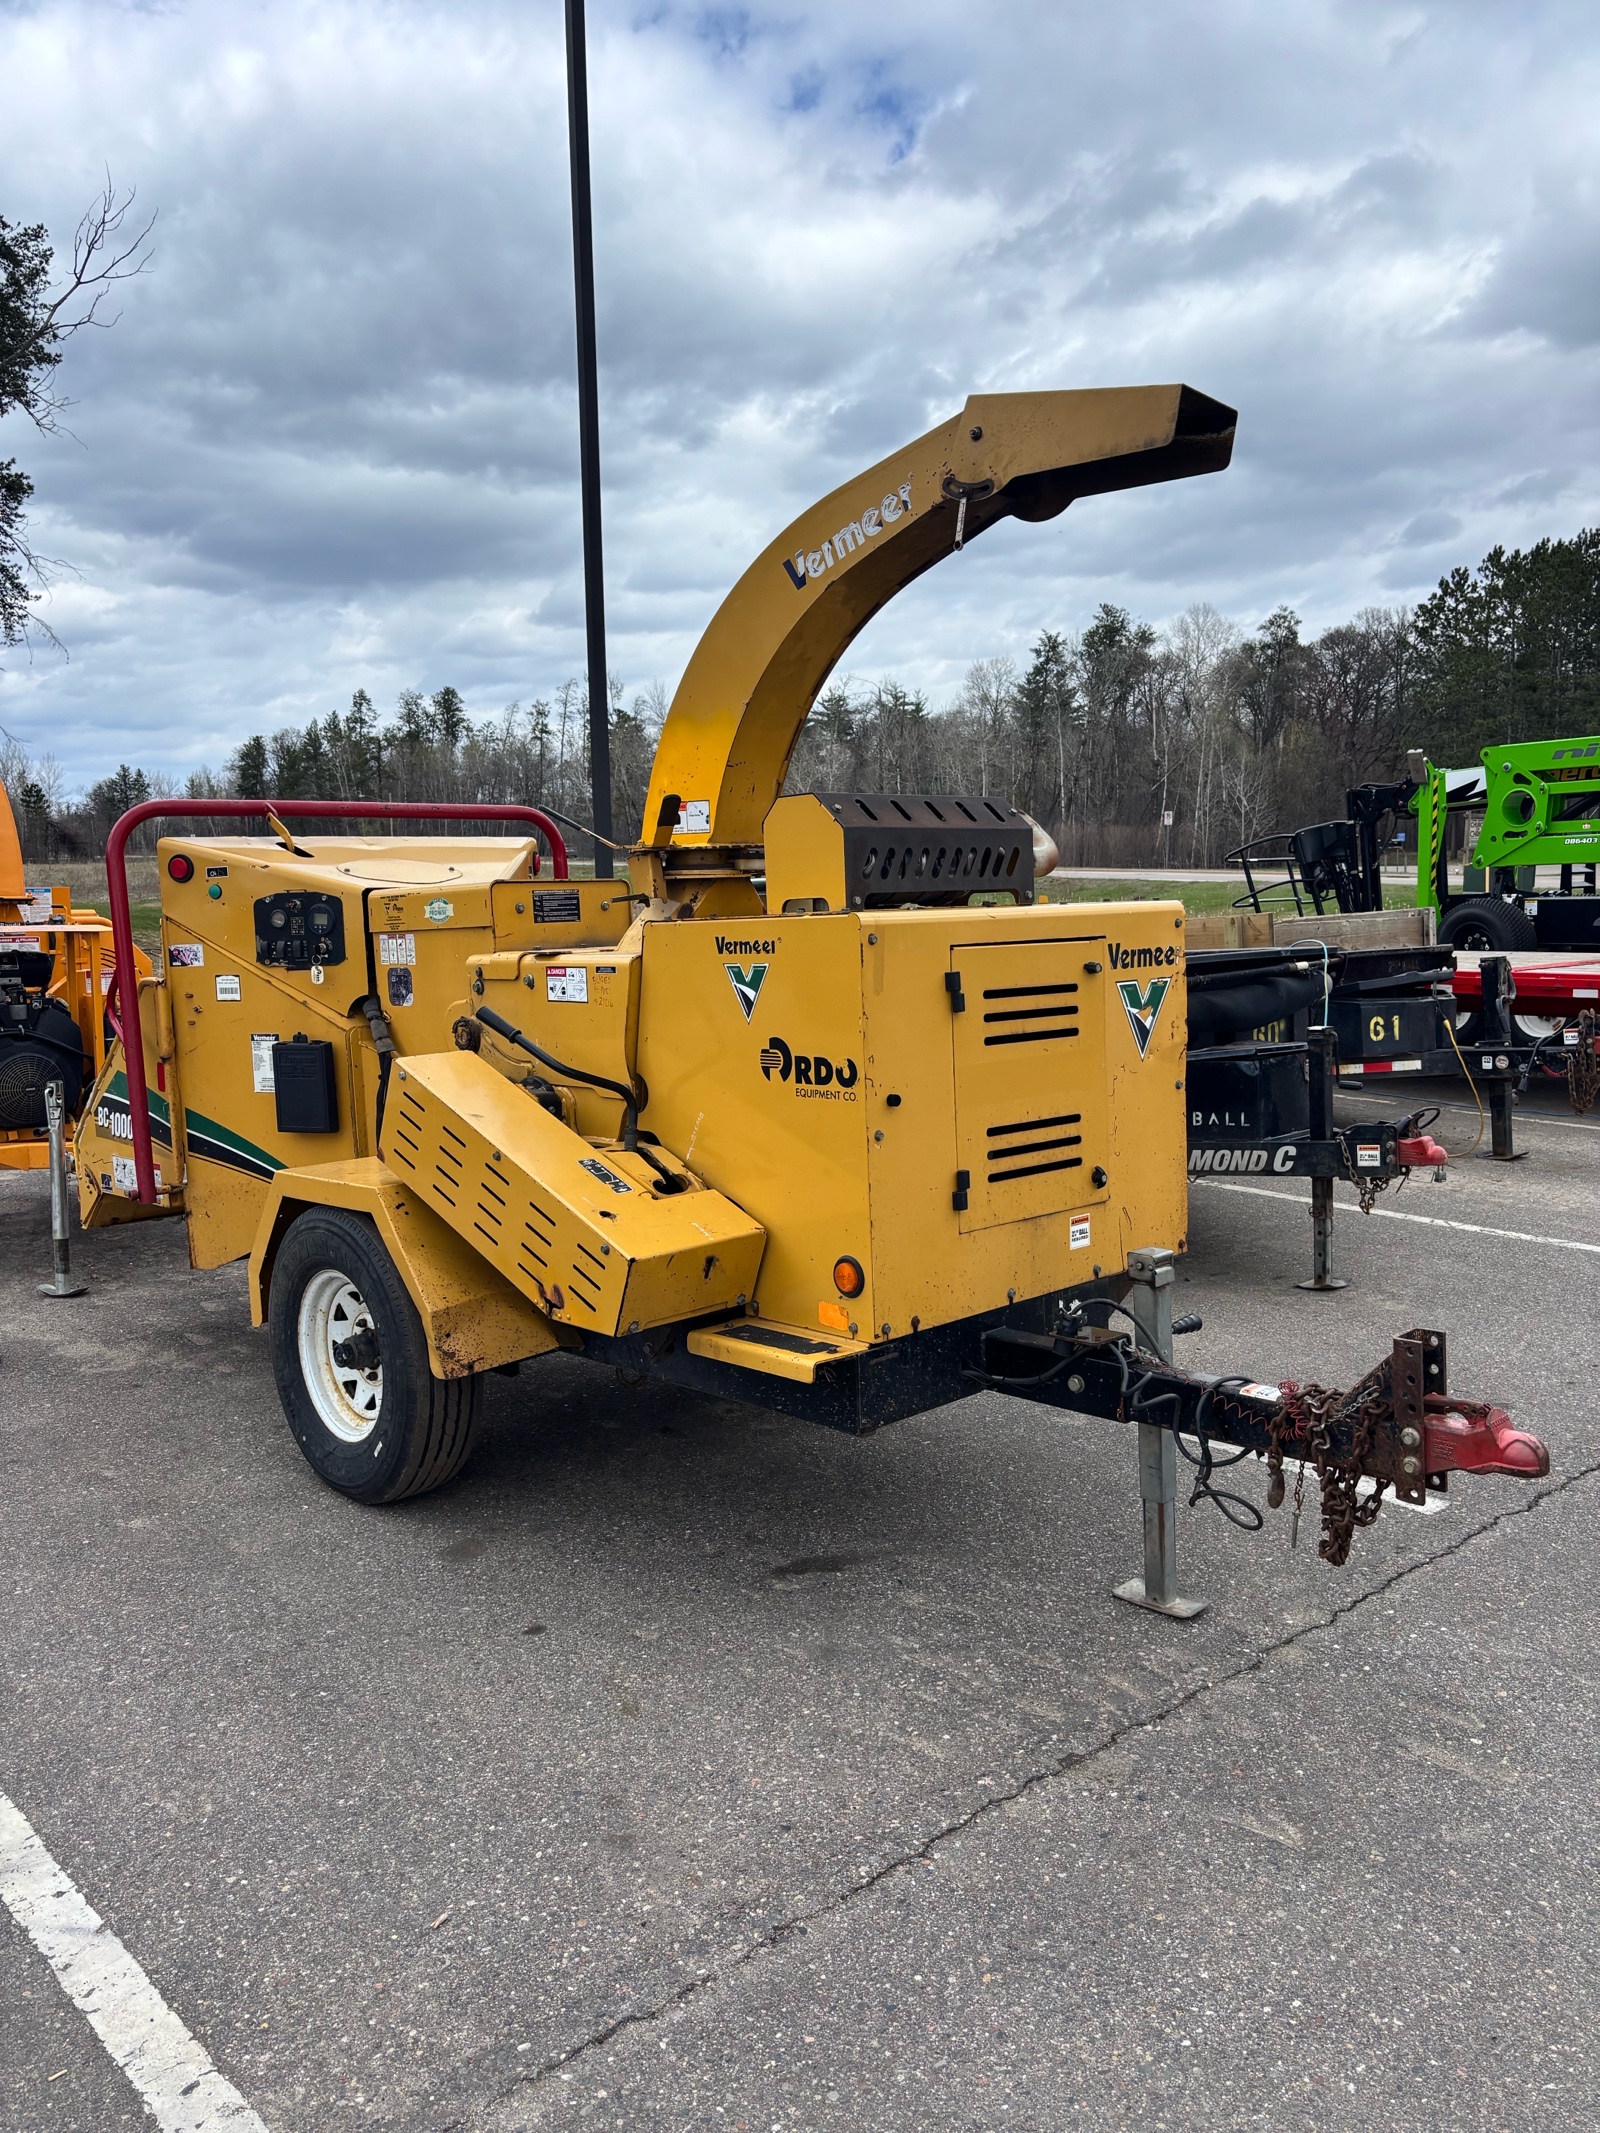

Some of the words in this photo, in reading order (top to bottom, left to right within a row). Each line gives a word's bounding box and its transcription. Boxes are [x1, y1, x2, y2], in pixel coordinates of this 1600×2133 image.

[783, 482, 912, 590] Vermeer
[795, 1088, 841, 1101] EQUIPMENT
[843, 1091, 859, 1102] CO.
[1192, 1111, 1250, 1126] BALL
[1188, 1149, 1268, 1171] MOND
[1273, 1145, 1297, 1172] C
